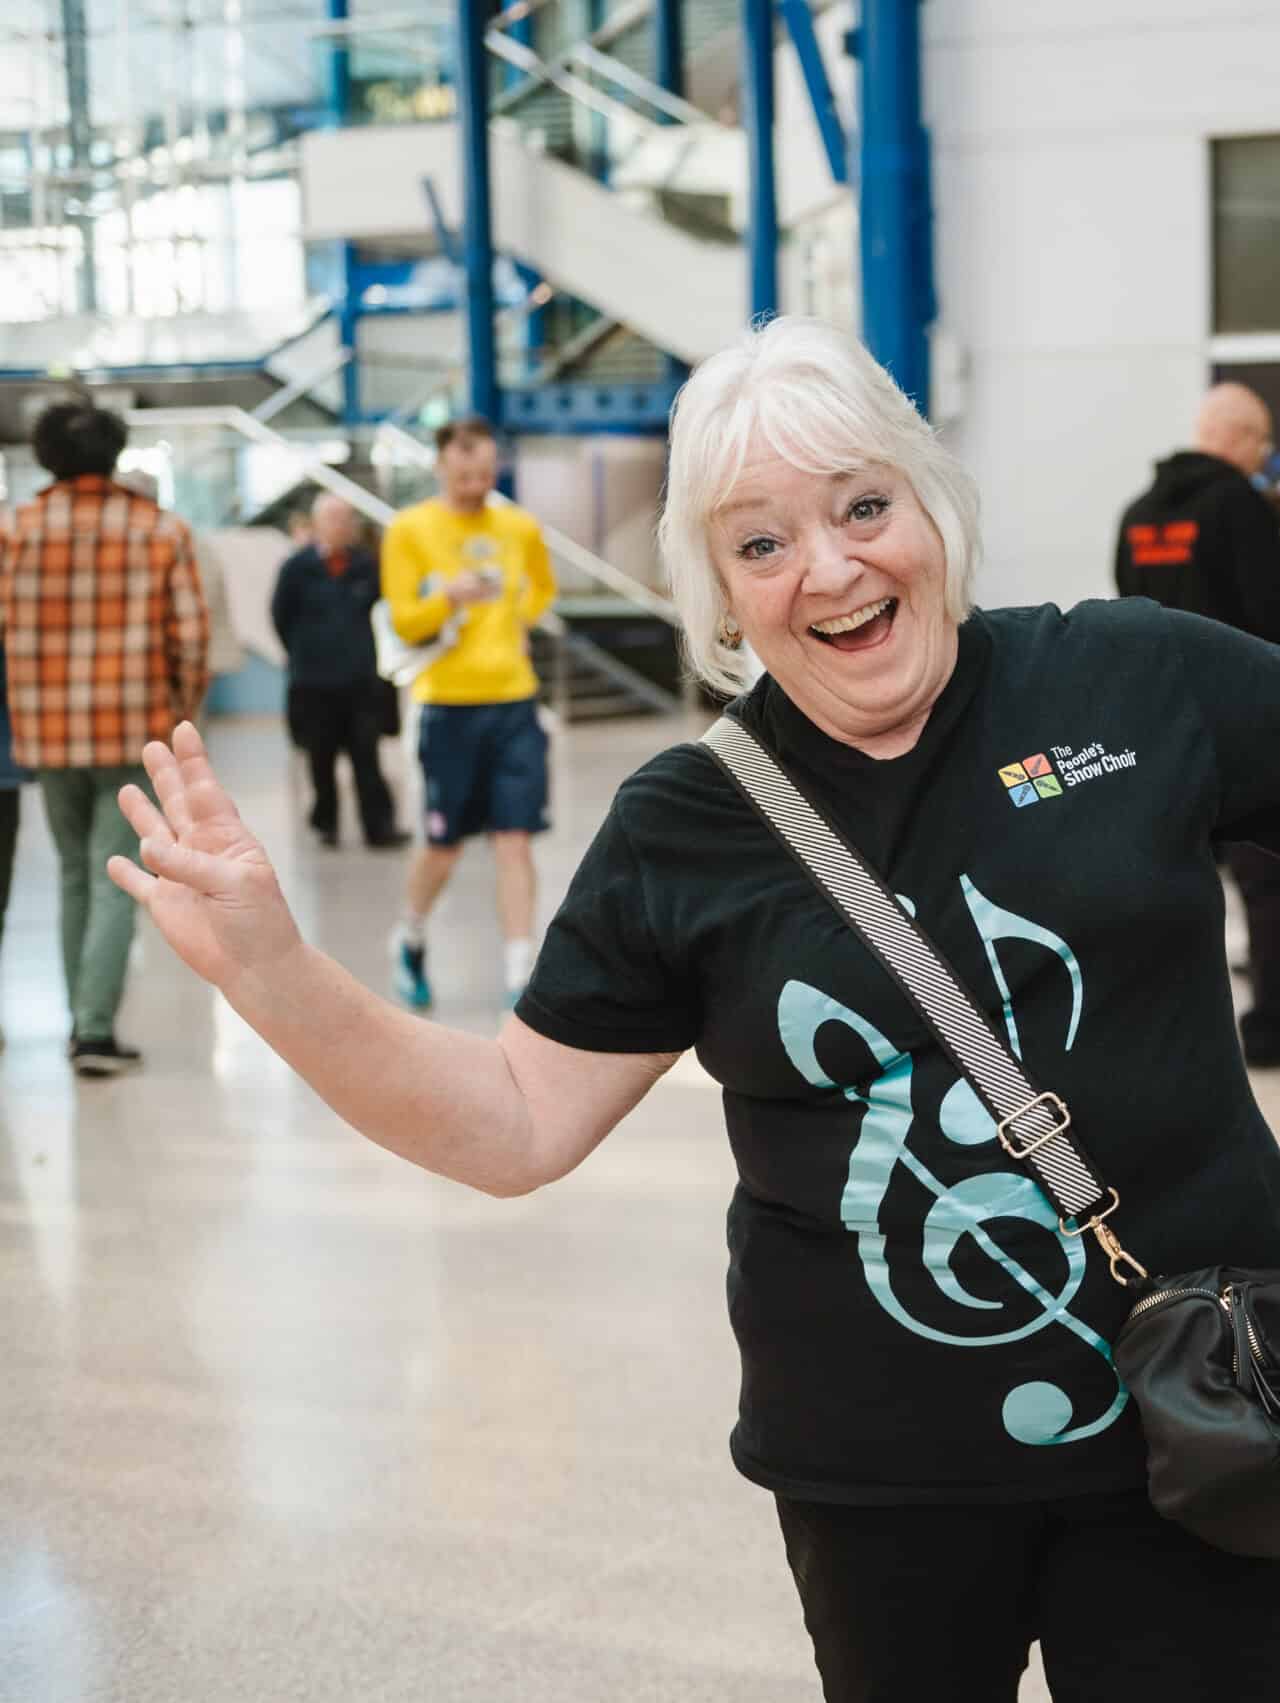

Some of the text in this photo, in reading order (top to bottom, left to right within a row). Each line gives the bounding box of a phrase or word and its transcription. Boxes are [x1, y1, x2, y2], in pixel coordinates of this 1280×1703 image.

[1050, 745, 1072, 759] The
[1056, 742, 1105, 775] People's
[1064, 749, 1137, 787] Show Choir
